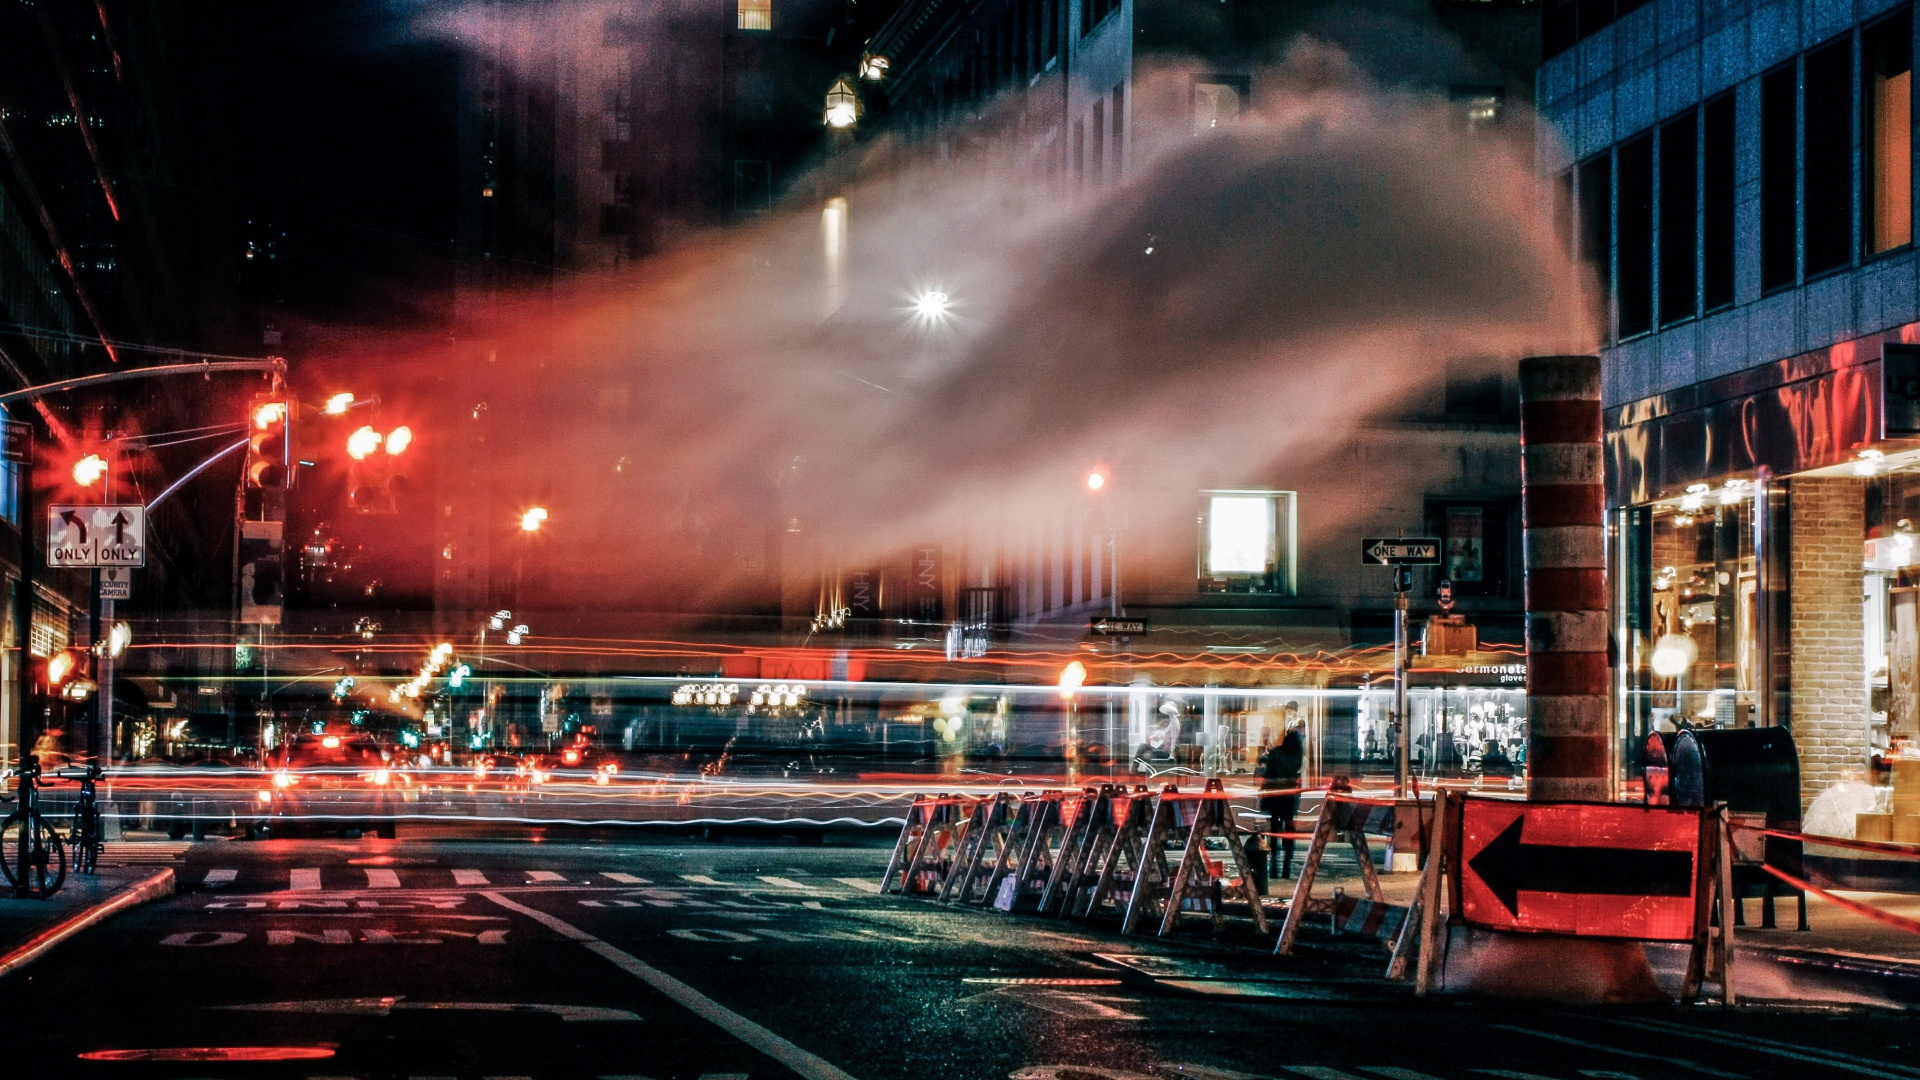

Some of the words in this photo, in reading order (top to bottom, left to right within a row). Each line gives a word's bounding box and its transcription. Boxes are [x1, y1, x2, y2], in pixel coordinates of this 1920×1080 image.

[55, 548, 91, 560] ONLY
[101, 548, 137, 561] ONLY
[1374, 546, 1396, 557] ONE
[1406, 546, 1430, 557] WAY
[1122, 622, 1139, 631] WAY
[204, 900, 467, 909] ONLY
[158, 928, 511, 947] ONLY
